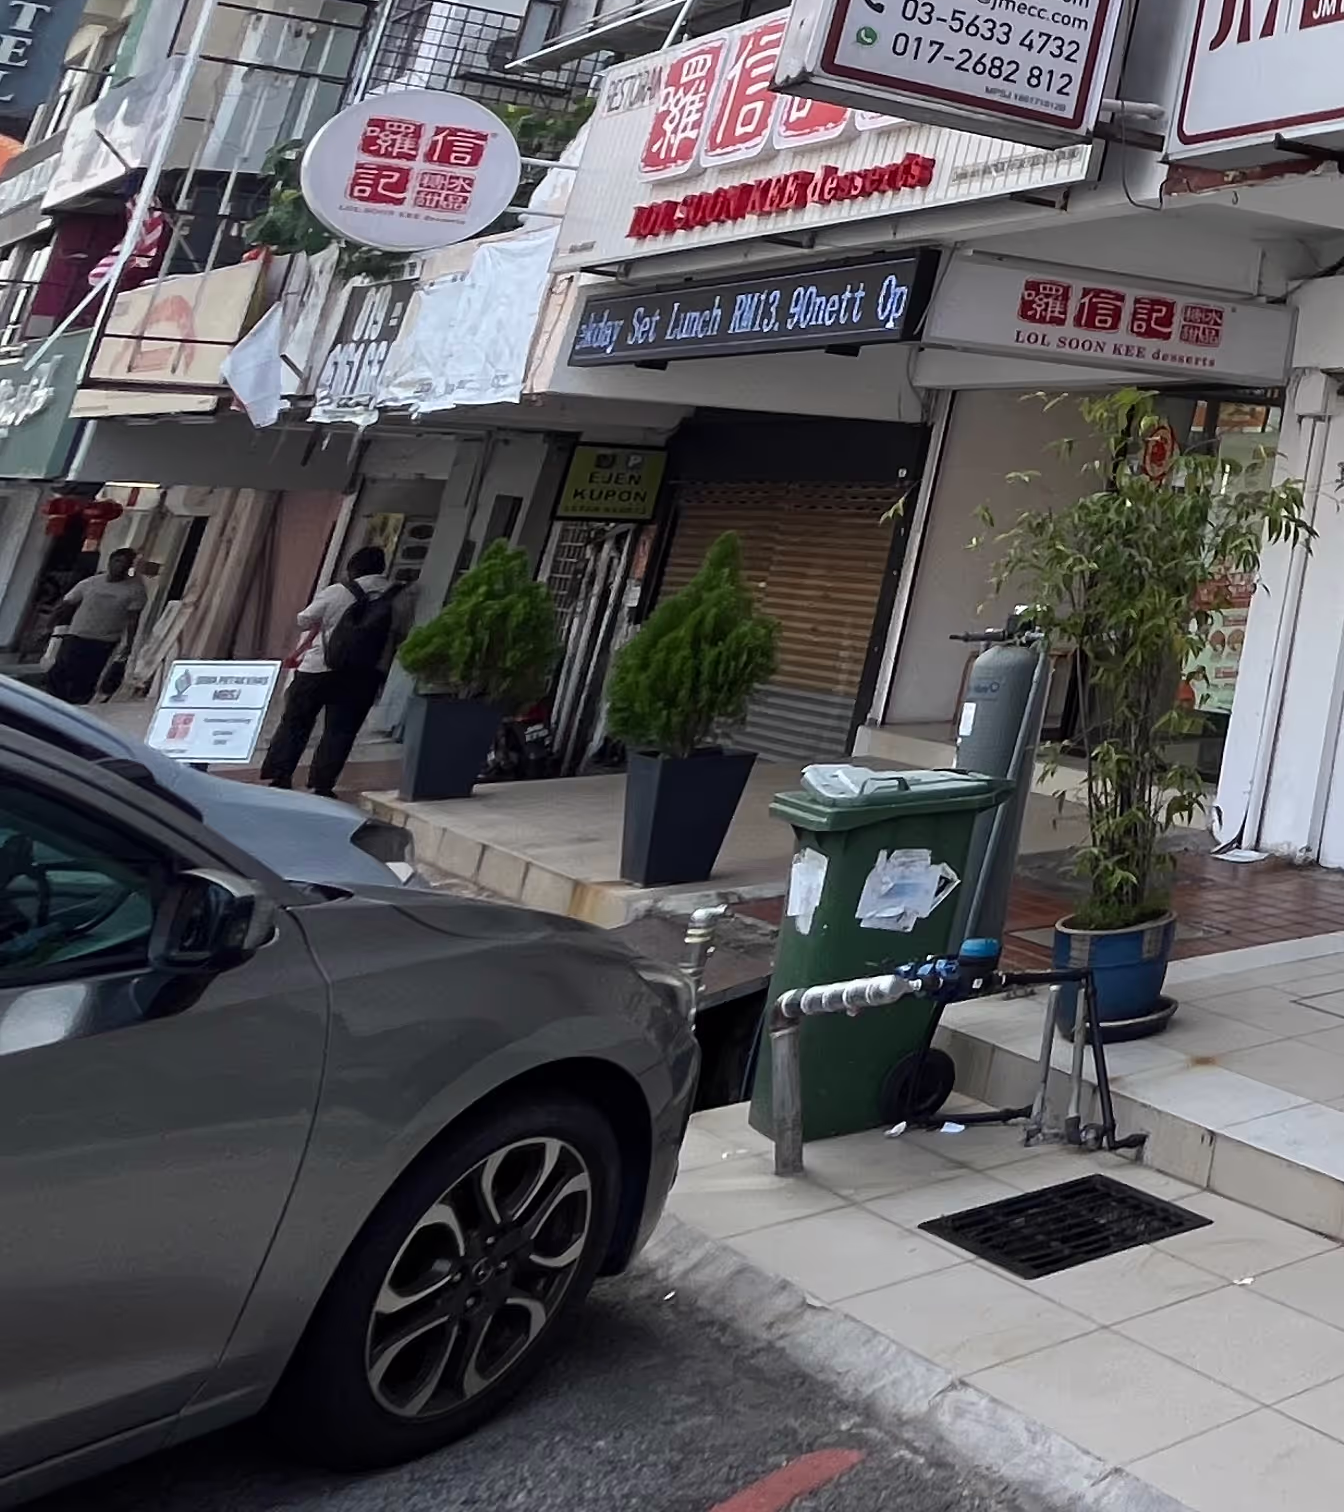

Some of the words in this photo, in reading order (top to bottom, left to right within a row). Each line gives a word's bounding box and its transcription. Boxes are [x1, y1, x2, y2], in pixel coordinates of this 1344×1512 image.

[891, 32, 1020, 85] 017-2682
[1026, 65, 1074, 97] 812
[1018, 28, 1081, 64] 4732
[627, 306, 661, 345] Set
[665, 295, 722, 340] Lunch
[1014, 329, 1051, 348] LOL
[1055, 335, 1108, 354] SOON
[1112, 343, 1147, 359] KEE
[1152, 348, 1216, 368] desserts
[572, 488, 648, 503] KUPON
[588, 471, 642, 486] EJEN
